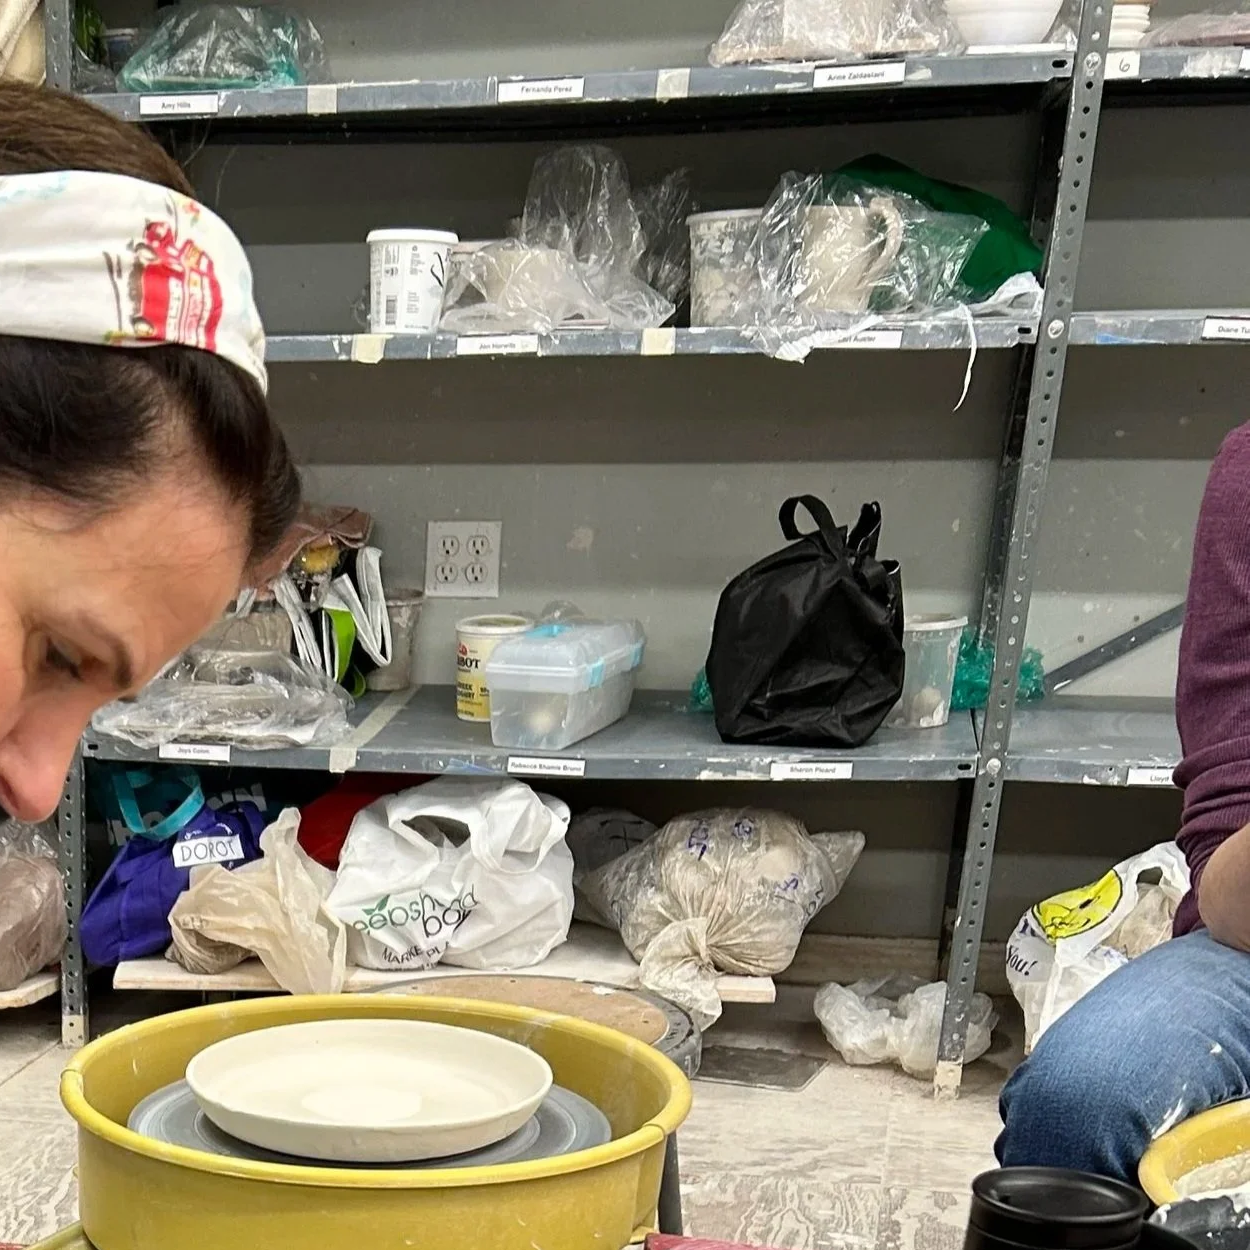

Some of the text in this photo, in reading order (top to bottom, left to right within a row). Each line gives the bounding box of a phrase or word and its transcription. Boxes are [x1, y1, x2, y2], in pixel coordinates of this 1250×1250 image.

[1119, 57, 1131, 73] 6
[161, 102, 176, 110] Amy
[180, 840, 237, 862] DOROT
[1006, 944, 1039, 976] You!
